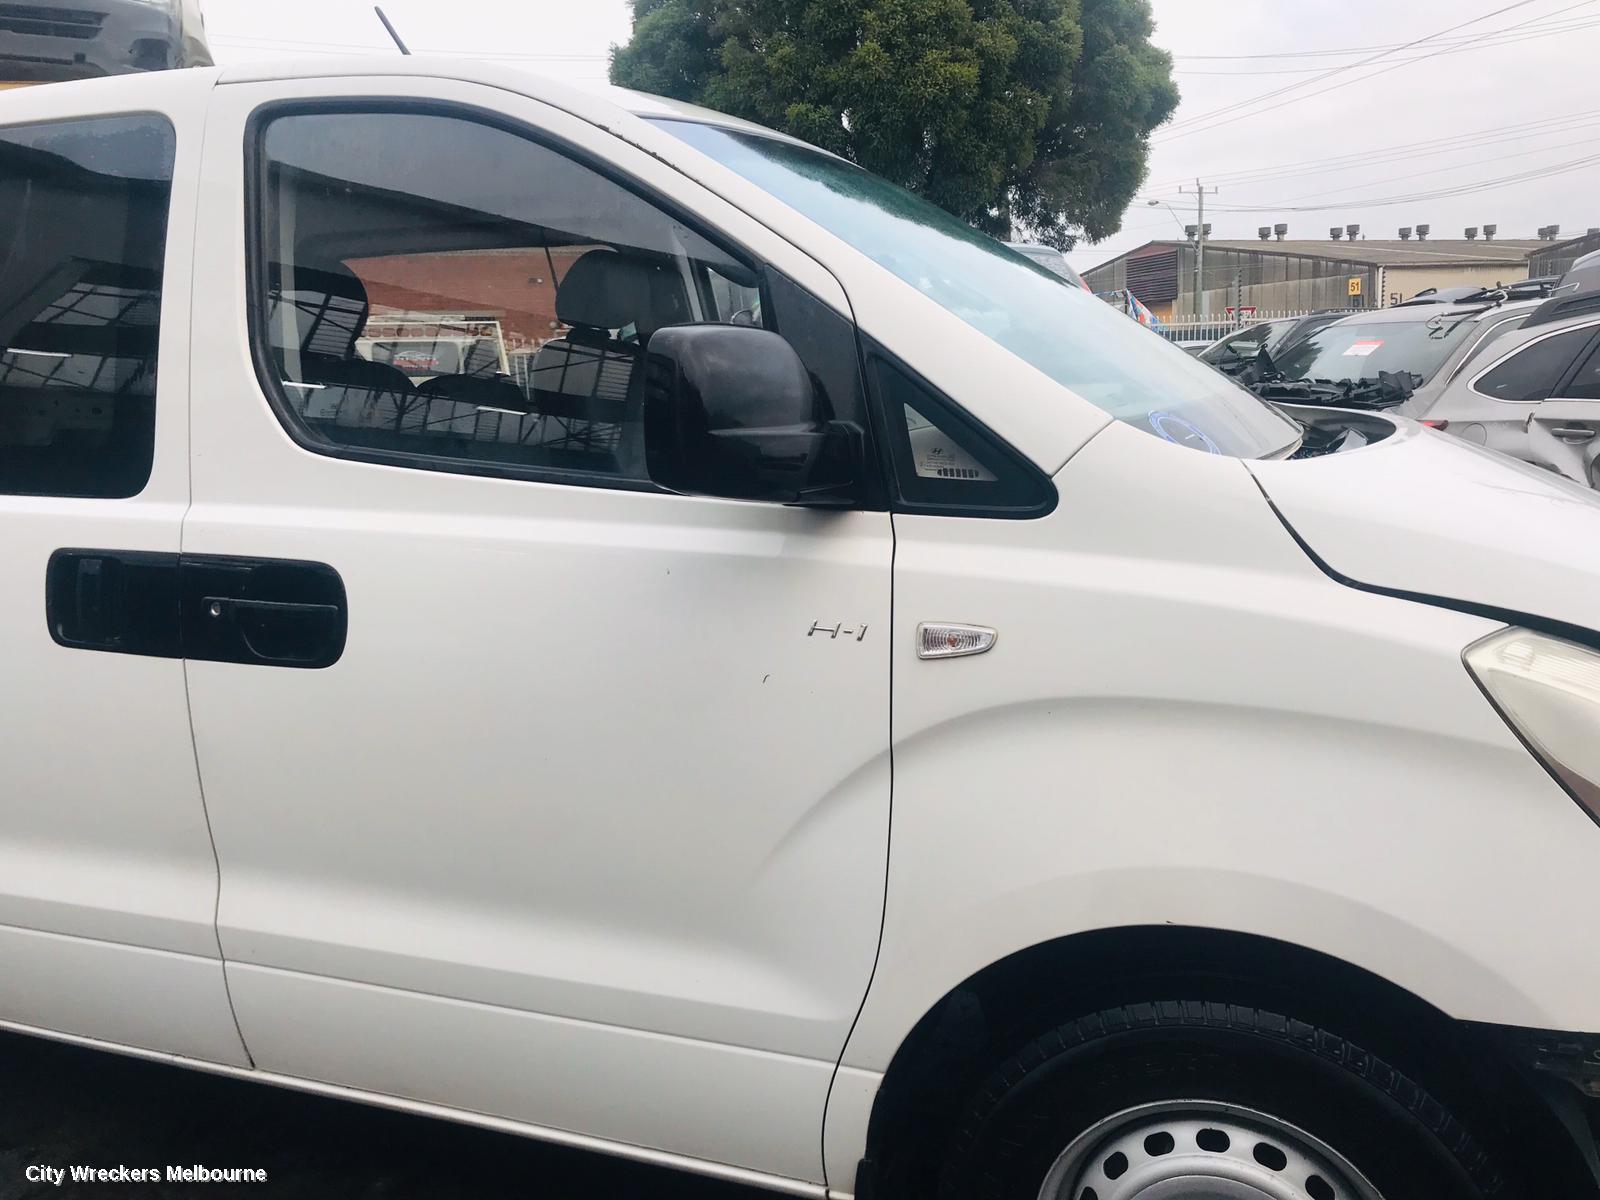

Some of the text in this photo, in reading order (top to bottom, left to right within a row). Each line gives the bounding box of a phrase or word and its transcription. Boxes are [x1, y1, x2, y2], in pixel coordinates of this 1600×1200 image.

[1350, 281, 1360, 292] 51
[1390, 292, 1402, 305] 51
[808, 619, 868, 641] H-1
